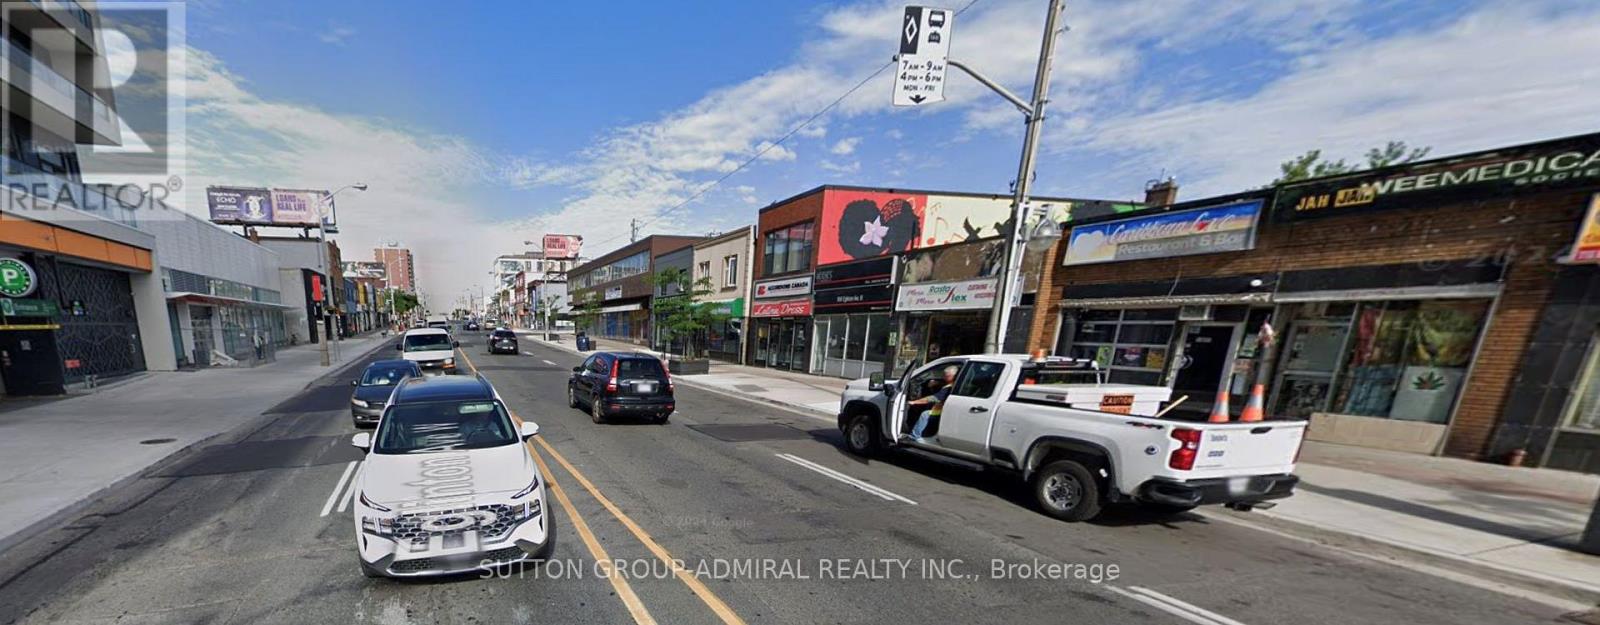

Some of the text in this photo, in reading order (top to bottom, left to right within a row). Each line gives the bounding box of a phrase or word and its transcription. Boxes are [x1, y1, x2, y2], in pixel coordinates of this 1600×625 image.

[924, 84, 935, 92] FRI
[1295, 195, 1330, 212] JAH
[1119, 231, 1246, 256] Restaurant & Bar
[2, 268, 19, 284] P
[1103, 395, 1132, 405] CAUTION
